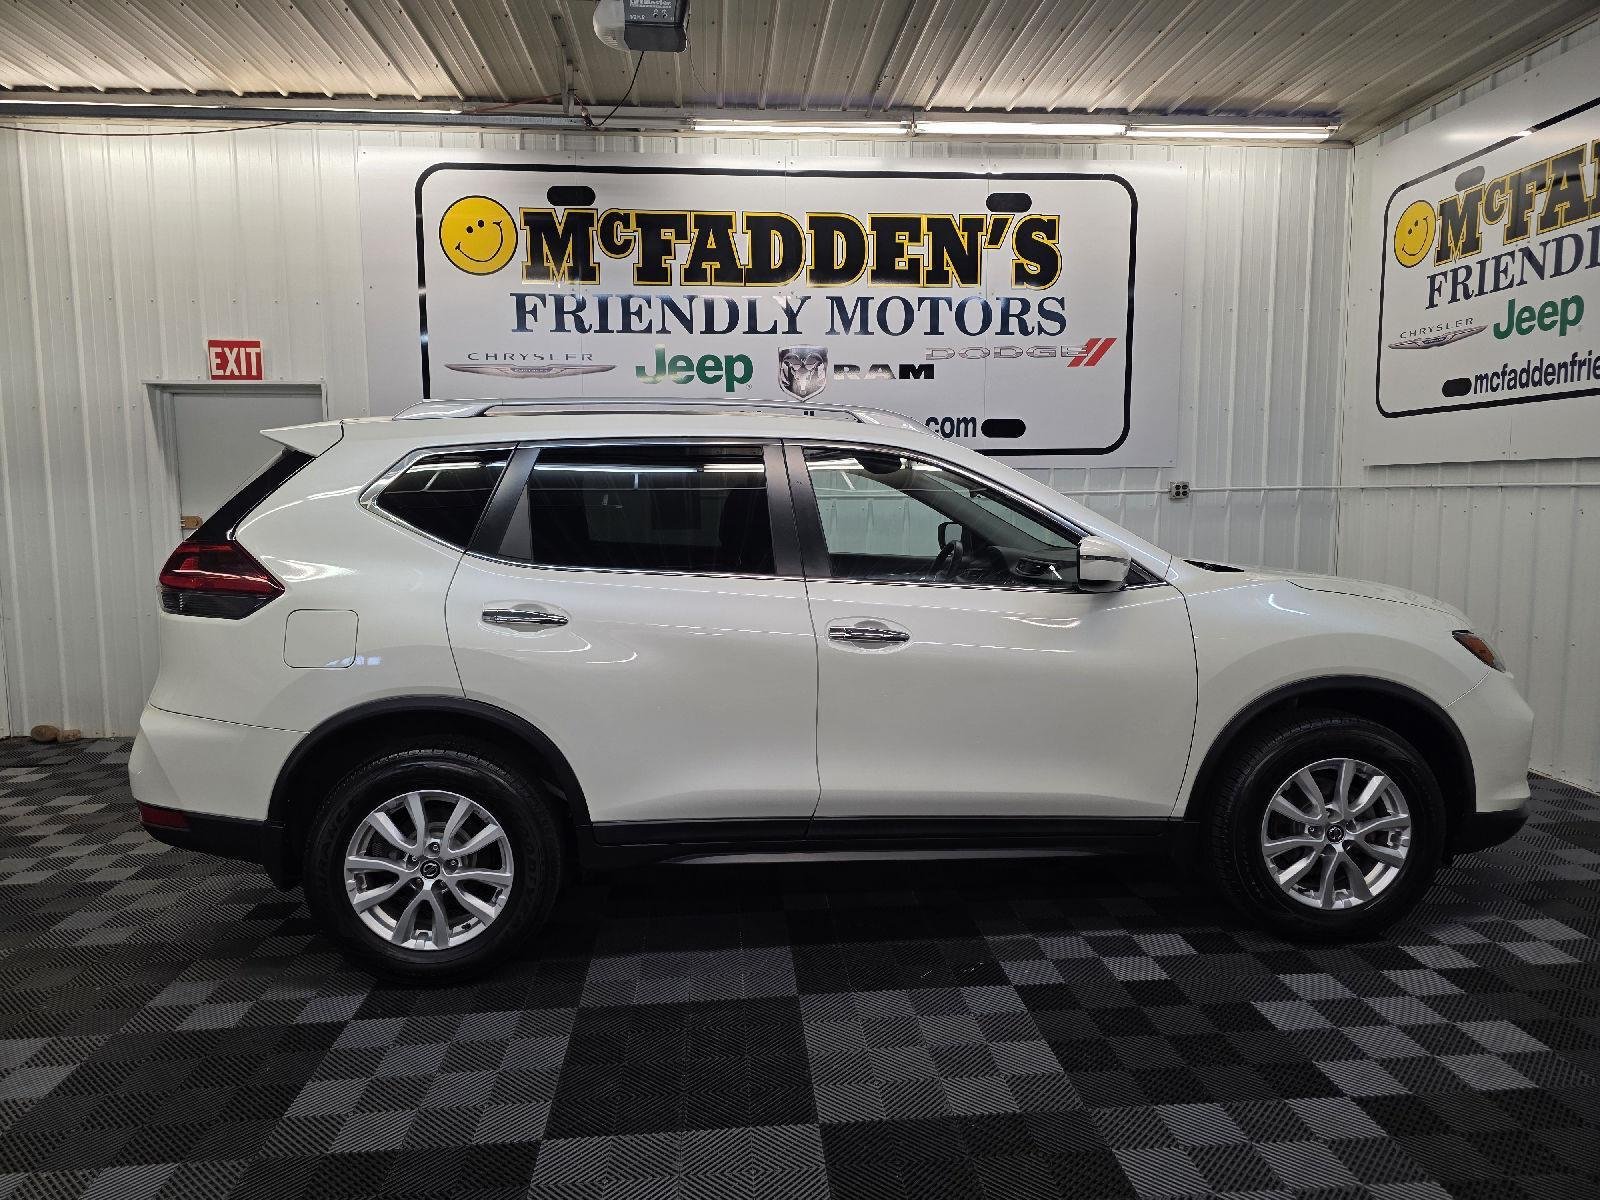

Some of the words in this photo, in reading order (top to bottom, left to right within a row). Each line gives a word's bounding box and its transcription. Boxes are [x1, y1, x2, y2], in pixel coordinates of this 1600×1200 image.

[1434, 138, 1600, 267] McFA
[510, 292, 811, 335] FRIENDLY
[825, 295, 1067, 337] MOTORS
[1399, 317, 1474, 339] CHRYSLER
[1493, 293, 1585, 340] Jeep
[209, 346, 262, 376] EXIT
[467, 352, 593, 362] CHRYSLER
[635, 343, 754, 392] Jeep
[925, 345, 1089, 361] DODGE
[833, 363, 935, 380] RAM
